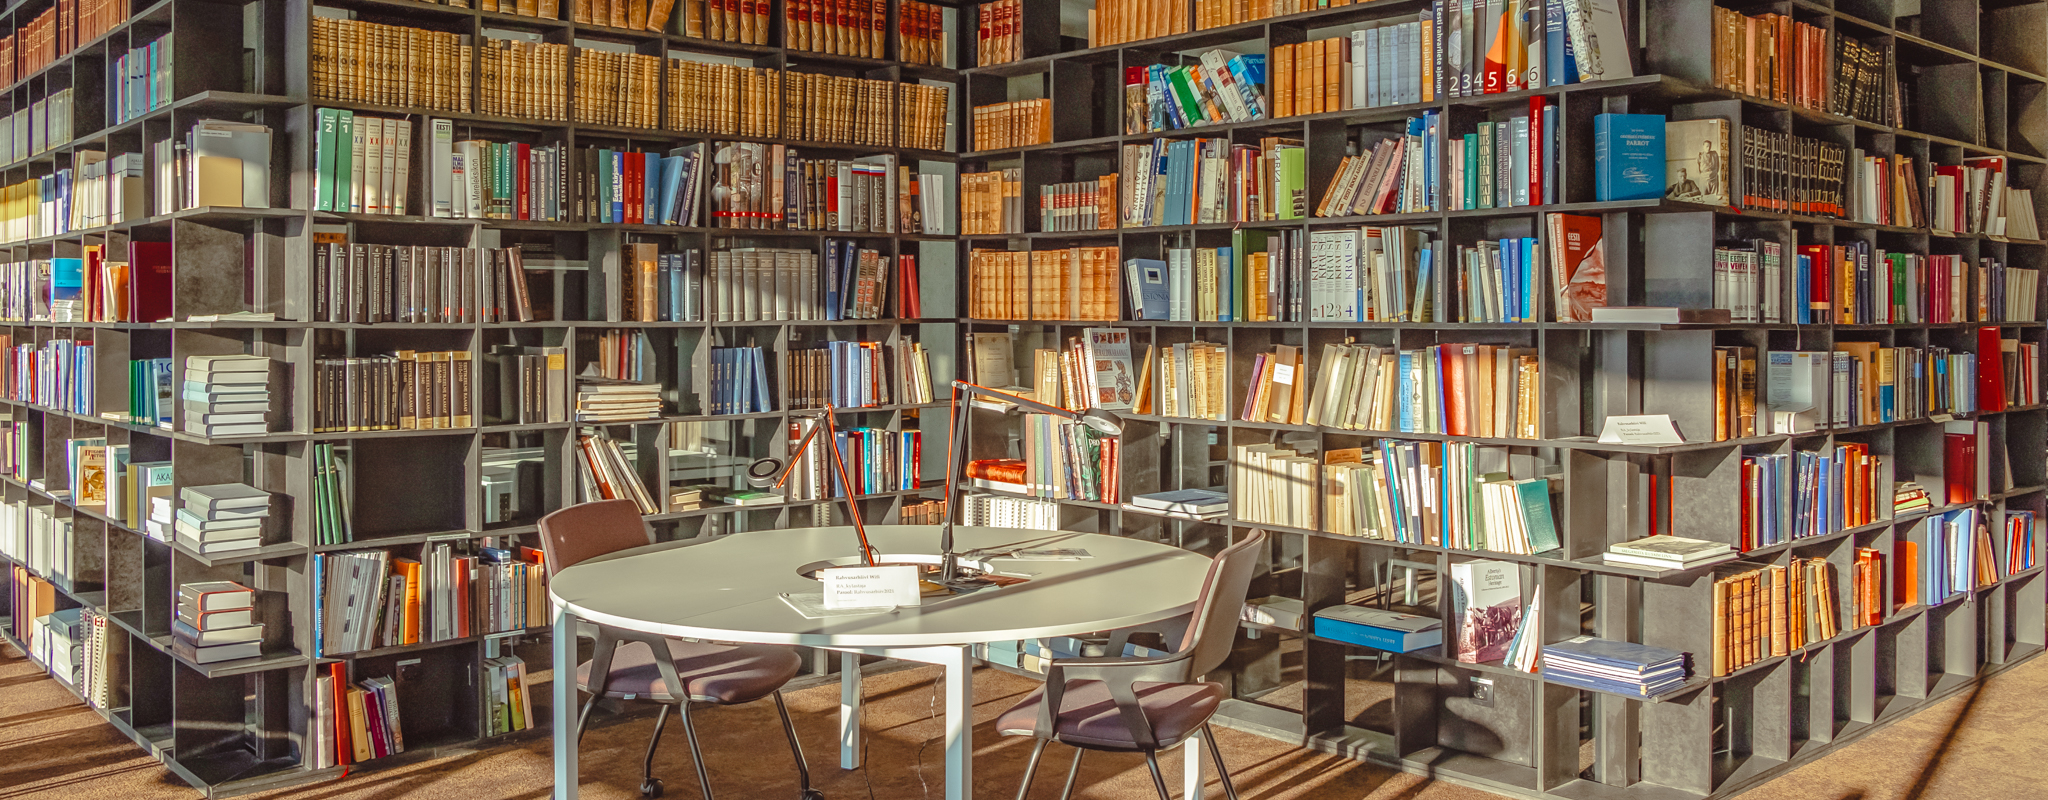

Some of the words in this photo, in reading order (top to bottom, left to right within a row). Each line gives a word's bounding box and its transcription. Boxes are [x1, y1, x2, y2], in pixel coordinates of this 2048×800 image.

[1474, 72, 1483, 86] 4
[1488, 72, 1497, 87] 5
[1507, 69, 1516, 84] 6
[1529, 66, 1538, 81] 6
[1450, 76, 1458, 91] 2
[1462, 74, 1471, 88] 3
[325, 124, 332, 132] 2
[343, 125, 348, 133] 1
[1133, 170, 1141, 211] TALLINN
[1568, 233, 1580, 242] EESTI
[1321, 305, 1324, 318] 1
[1327, 303, 1334, 317] 2
[1336, 305, 1341, 318] 3
[1345, 302, 1353, 317] 4
